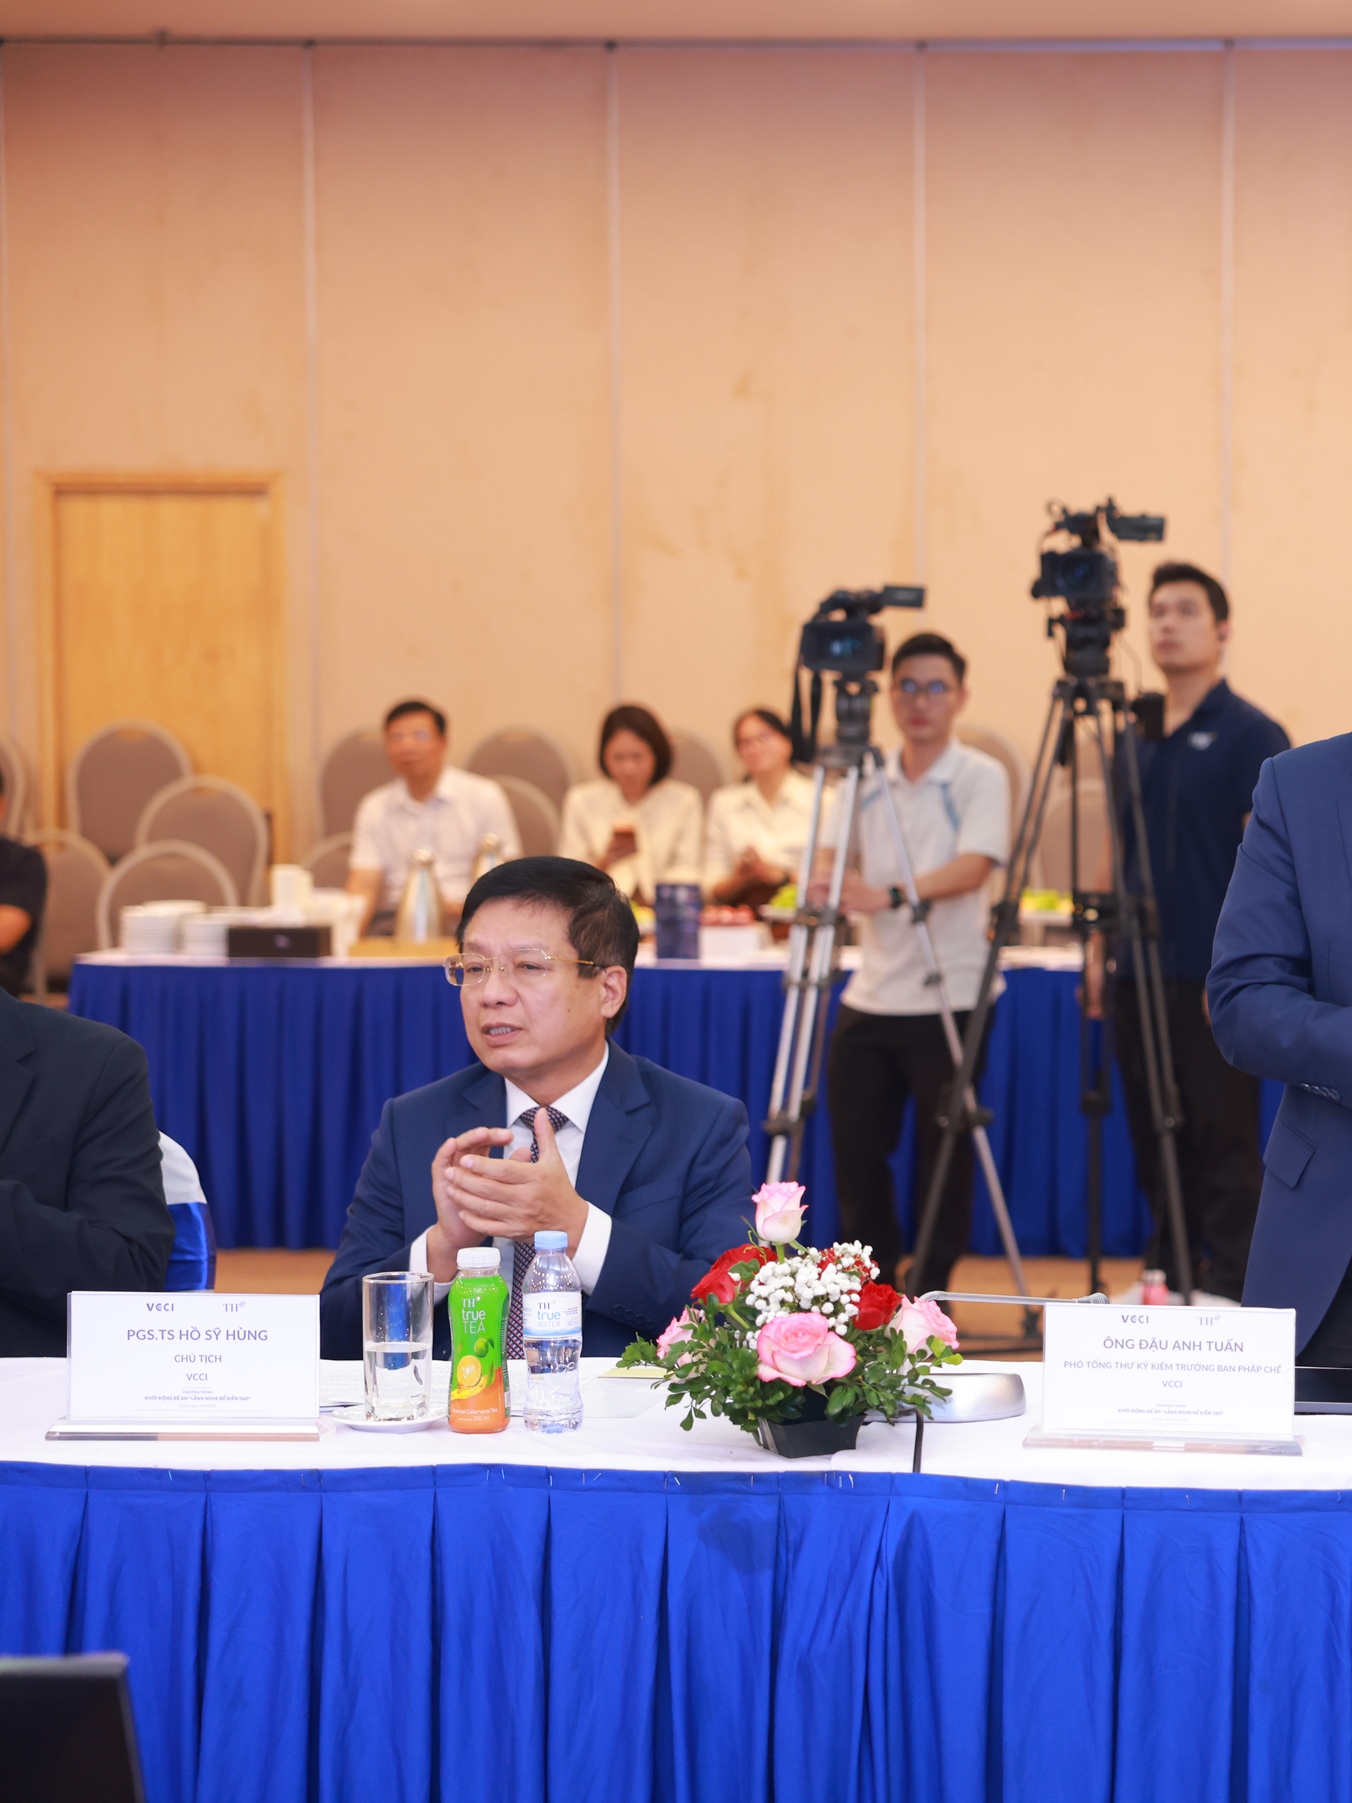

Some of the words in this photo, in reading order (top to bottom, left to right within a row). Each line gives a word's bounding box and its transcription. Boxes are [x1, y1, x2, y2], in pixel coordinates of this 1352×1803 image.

[146, 1303, 175, 1312] VCCI
[222, 1303, 239, 1313] TH
[461, 1298, 476, 1308] TH
[461, 1308, 486, 1321] true
[537, 1310, 561, 1321] true
[1121, 1314, 1149, 1324] VCCI
[1197, 1316, 1214, 1326] TH
[462, 1320, 486, 1334] TEA
[127, 1329, 175, 1341] PGS.TS
[179, 1326, 201, 1341] HỒ
[205, 1326, 222, 1341] SỸ
[226, 1326, 268, 1341] HÙNG
[1103, 1336, 1135, 1350] ÔNG
[1138, 1337, 1169, 1352] ĐẬU
[1172, 1340, 1202, 1352] ANH
[1205, 1338, 1244, 1352] TUẤN
[174, 1352, 196, 1364] CHỦ
[199, 1354, 222, 1365] TỊCH
[1063, 1359, 1084, 1369] PHÓ
[1086, 1357, 1112, 1370] TỔNG
[1114, 1360, 1135, 1370] THƯ
[1136, 1360, 1149, 1370] KÝ
[1217, 1363, 1236, 1373] BAN
[1238, 1362, 1262, 1374] PHÁP
[1263, 1363, 1282, 1374] CHẾ
[186, 1372, 208, 1382] VCCI
[1162, 1380, 1183, 1388] VCCI
